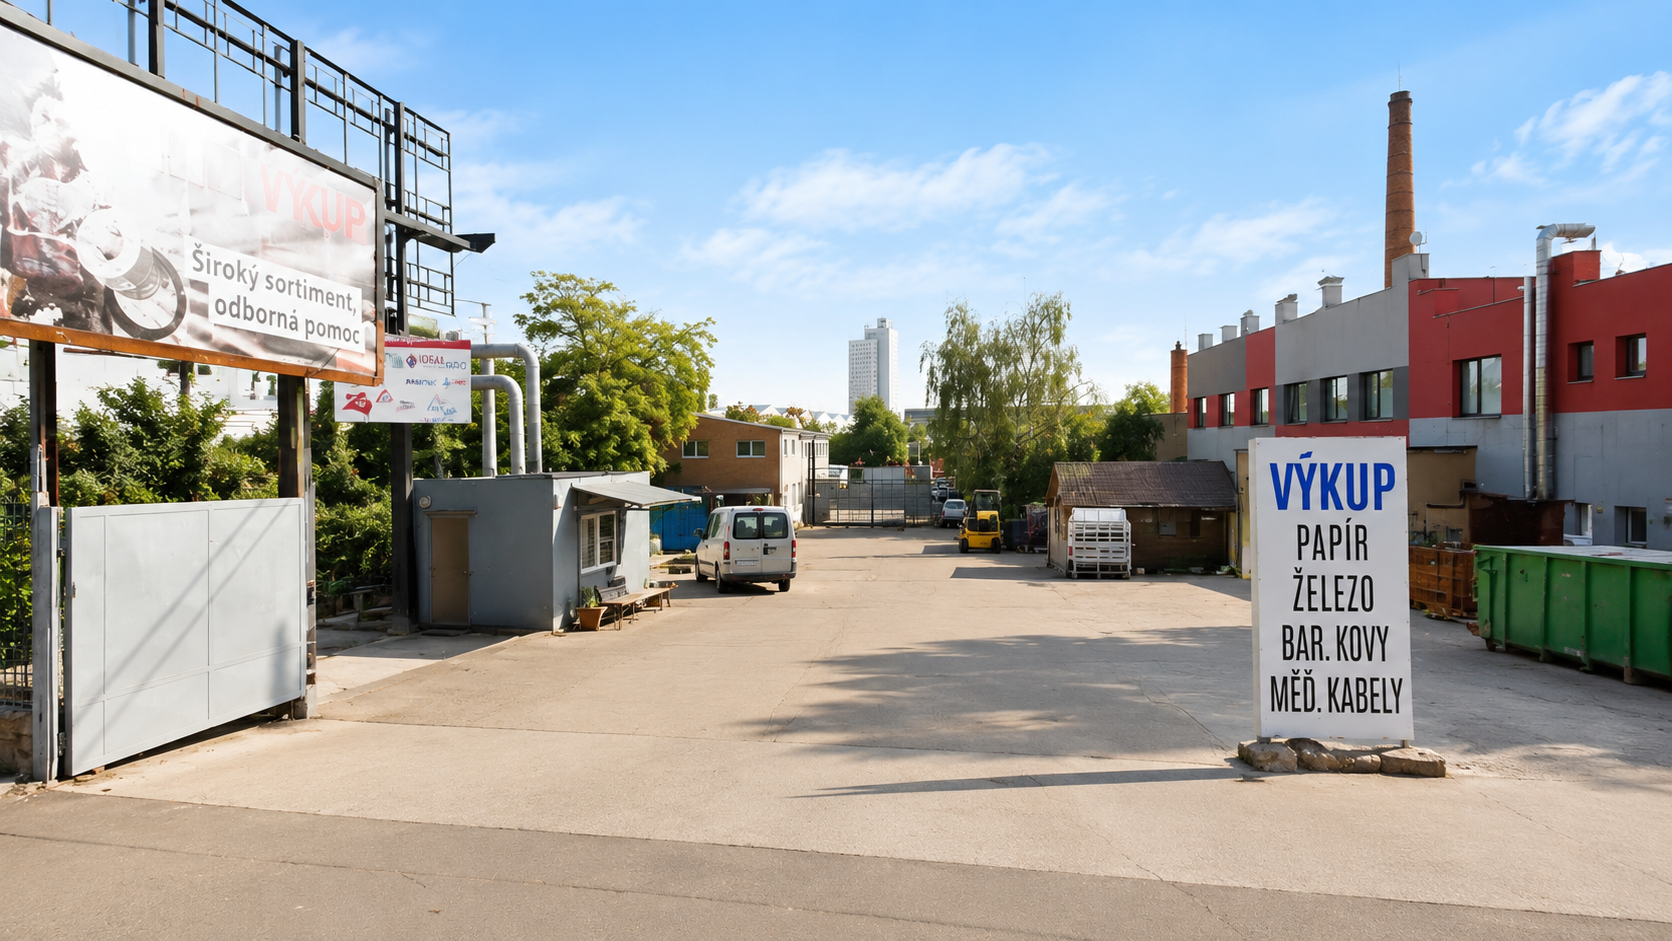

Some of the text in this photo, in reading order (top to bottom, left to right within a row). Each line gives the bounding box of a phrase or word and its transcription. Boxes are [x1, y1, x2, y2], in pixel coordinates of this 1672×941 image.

[260, 164, 366, 239] VÝKUP
[192, 243, 357, 316] Široký sortiment,
[214, 295, 360, 344] odborná pomoc
[1269, 451, 1396, 511] VÝKUP
[1297, 517, 1369, 561] PAPÍR
[1293, 567, 1374, 612] ŽELEZO
[1282, 625, 1389, 662] BAR. KOVY
[1270, 669, 1403, 714] MĚĎ. KABELY
